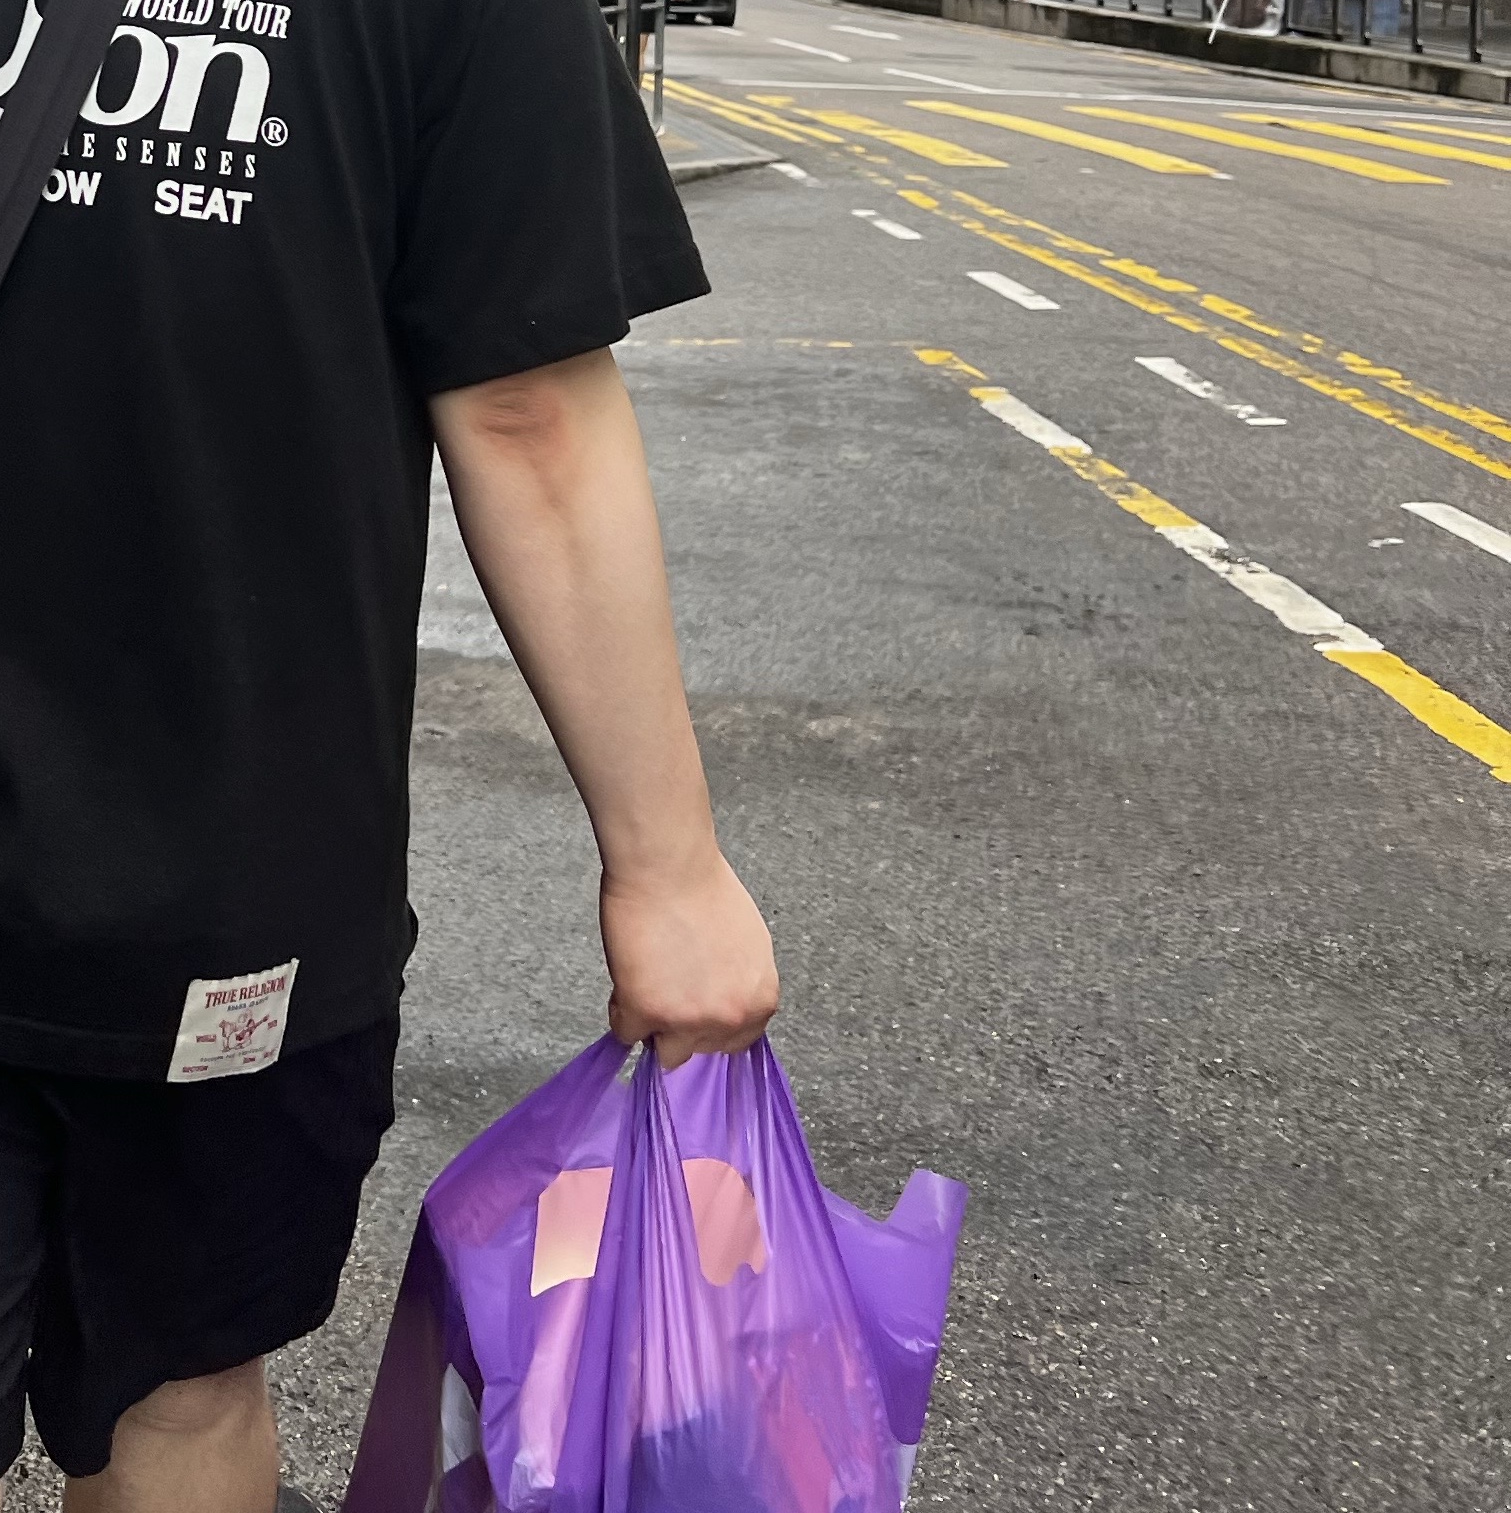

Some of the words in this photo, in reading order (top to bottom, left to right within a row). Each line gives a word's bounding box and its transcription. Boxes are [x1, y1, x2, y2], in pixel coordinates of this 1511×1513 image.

[115, 136, 256, 179] SENSES
[154, 179, 253, 225] SEAT
[205, 989, 238, 1009] TRUE
